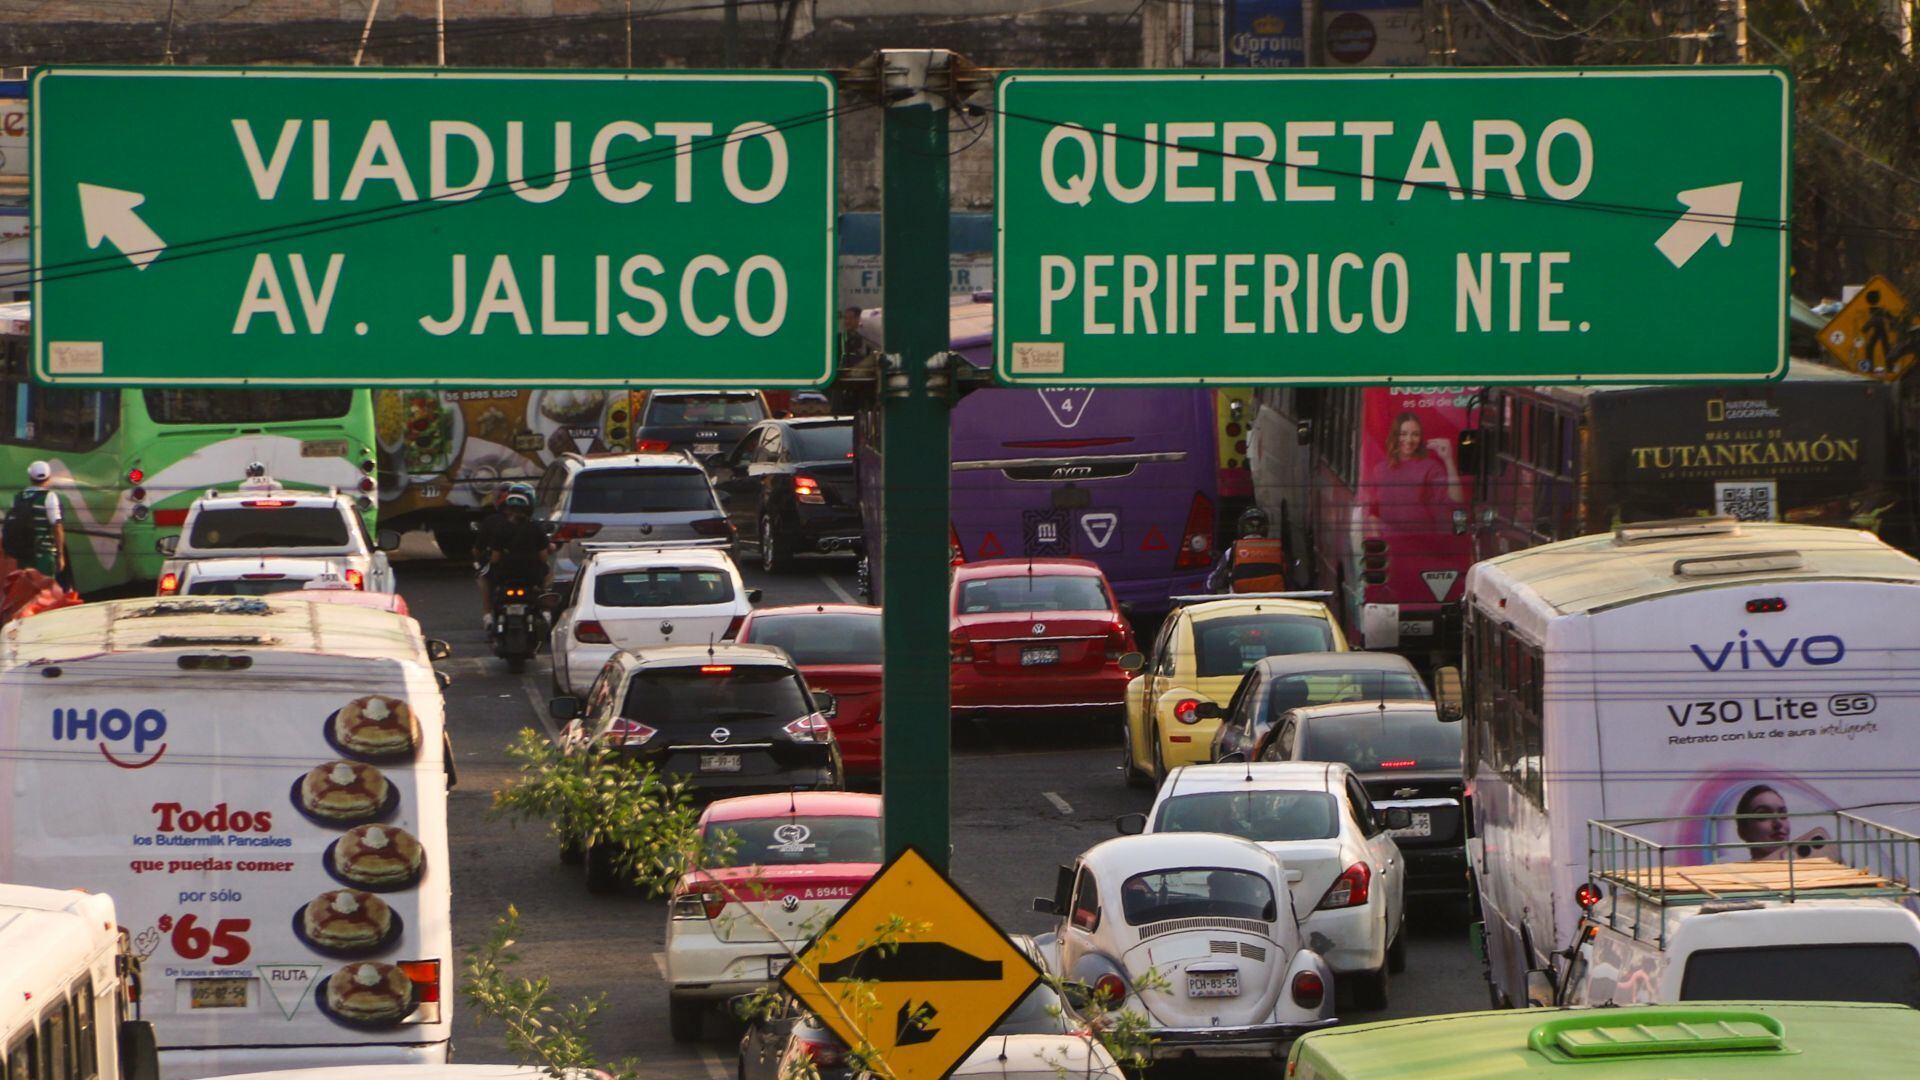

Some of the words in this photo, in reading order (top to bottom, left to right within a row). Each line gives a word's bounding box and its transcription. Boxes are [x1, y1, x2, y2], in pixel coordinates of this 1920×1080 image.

[232, 119, 788, 203] VIADUCTO
[1041, 119, 1593, 206] QUERETARO
[233, 254, 369, 336] AV.
[419, 254, 787, 336] JALISCO
[1041, 252, 1408, 334] PERIFERICO
[1456, 252, 1590, 334] NTE.
[1061, 398, 1073, 412] 4
[1726, 400, 1768, 409] NATIONAL
[1726, 408, 1780, 419] GEOGRAPHIC
[1767, 428, 1782, 439] DE
[1632, 434, 1859, 469] TUTANKAMÓN
[320, 574, 339, 582] TAXI
[1426, 572, 1453, 580] RUTA
[1690, 629, 1846, 672] vivo
[1667, 700, 1744, 727] V30
[1754, 697, 1819, 721] Lite
[1834, 697, 1869, 712] 5G
[1668, 734, 1718, 745] Retrato
[1721, 733, 1744, 742] con
[1747, 729, 1766, 740] luz
[1768, 728, 1784, 739] de
[1787, 728, 1817, 738] aura
[1819, 719, 1879, 741] inteligente
[152, 802, 272, 832] Todos
[133, 835, 152, 846] los
[156, 834, 225, 846] Buttermilk
[228, 835, 292, 847] Pancakes
[130, 860, 164, 874] que
[168, 857, 233, 874] puedas
[236, 860, 294, 872] comer
[179, 892, 206, 904] por
[209, 888, 242, 902] sólo
[804, 889, 814, 898] A
[165, 968, 178, 977] De
[181, 968, 208, 977] lunes
[215, 968, 253, 977] viernes
[272, 970, 308, 981] RUTA
[1189, 979, 1237, 990] PCH-83-58
